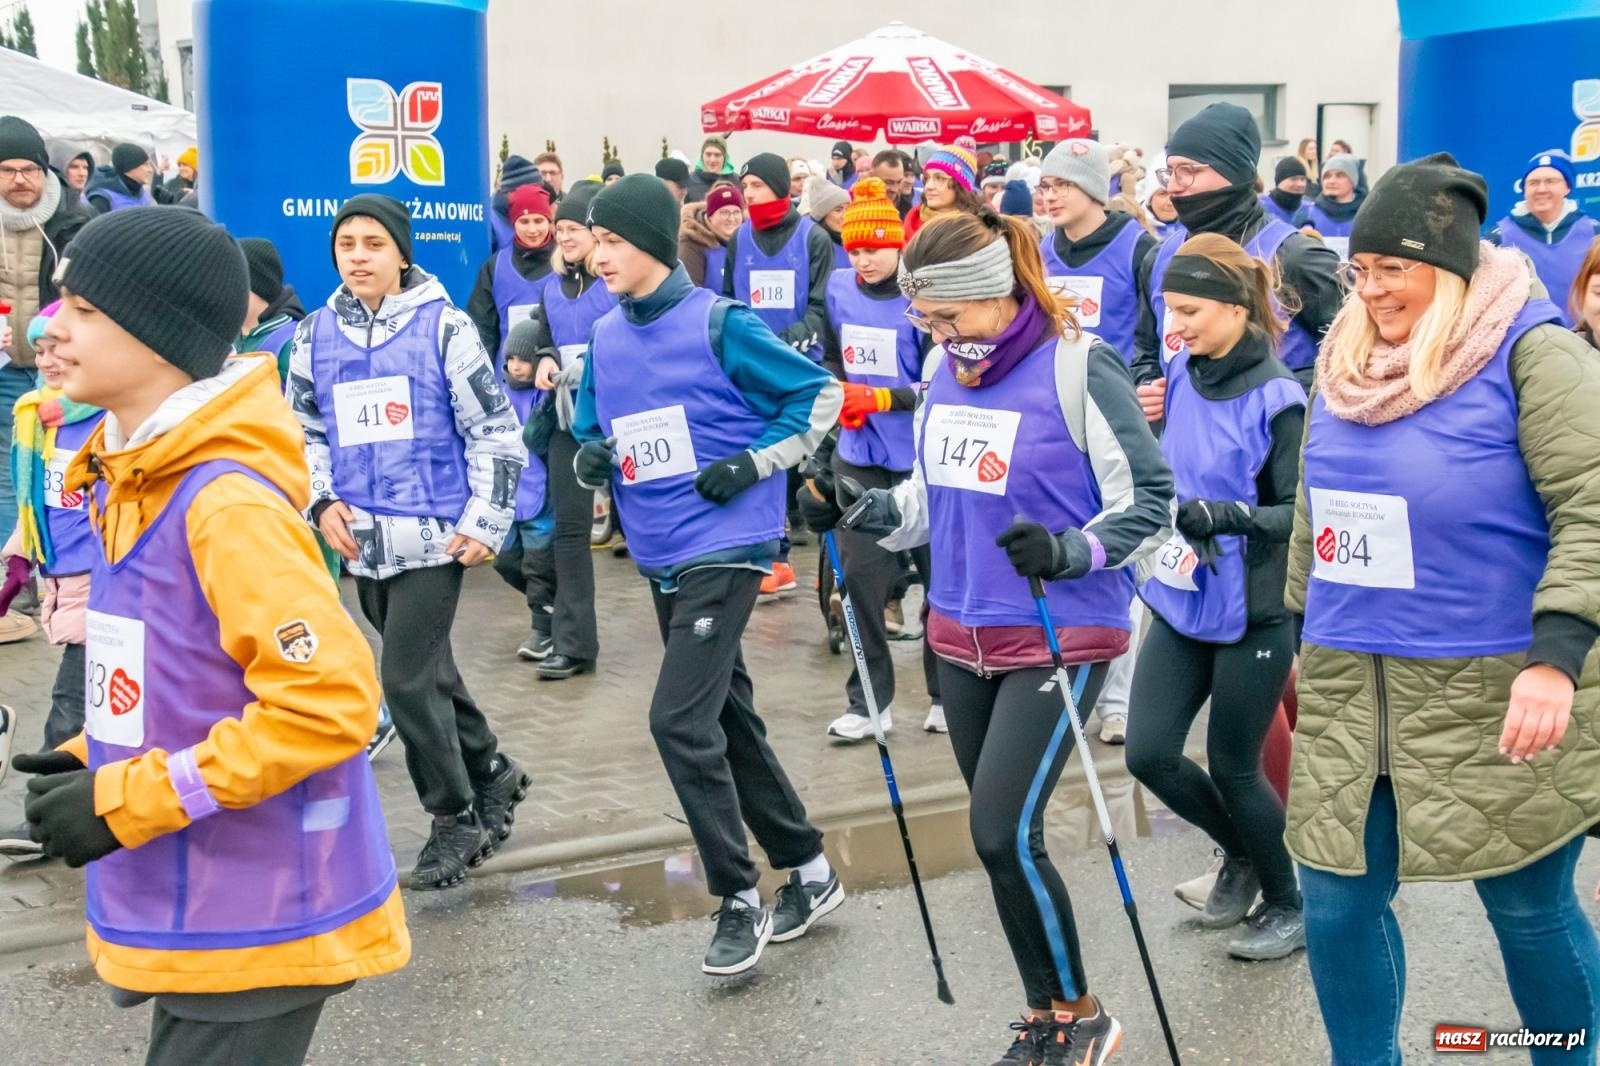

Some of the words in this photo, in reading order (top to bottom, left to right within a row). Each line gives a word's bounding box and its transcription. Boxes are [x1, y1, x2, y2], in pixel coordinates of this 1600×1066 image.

[808, 57, 869, 104] WARKA
[910, 59, 959, 108] WARKA
[817, 113, 860, 130] Classic
[893, 121, 937, 133] WARKA
[970, 117, 1012, 135] Classic
[282, 198, 348, 217] GMIN
[415, 231, 461, 243] zapamiętaj
[761, 286, 783, 300] 118
[855, 346, 878, 365] 34
[357, 403, 384, 427] 41
[630, 438, 671, 469] 130
[938, 436, 989, 468] 147
[1337, 530, 1372, 567] 84
